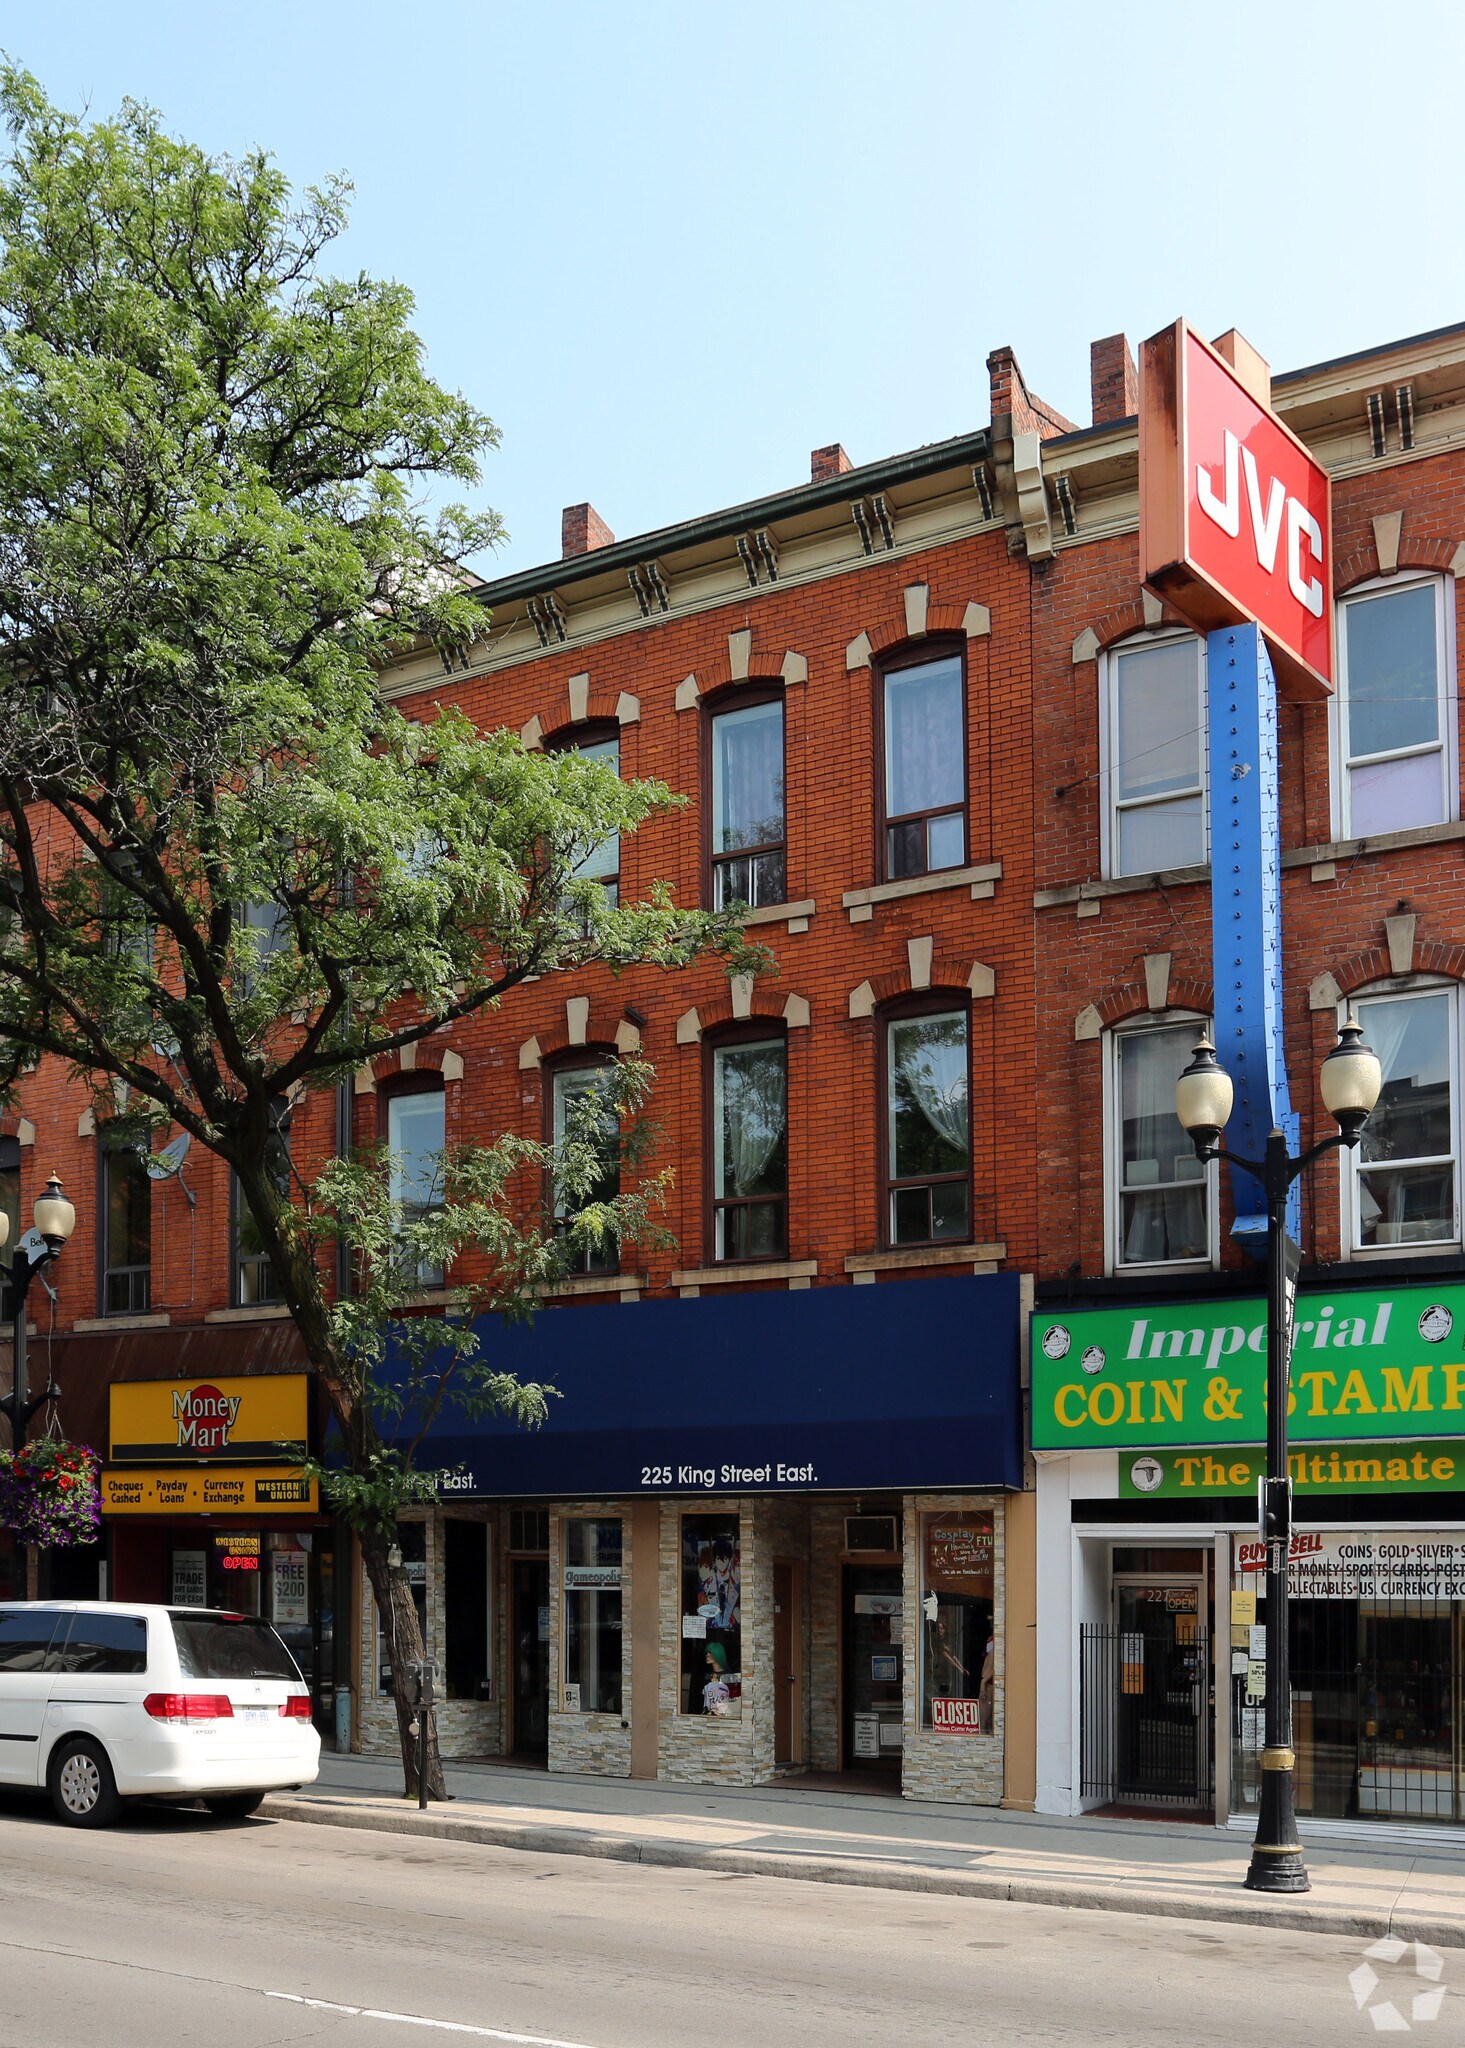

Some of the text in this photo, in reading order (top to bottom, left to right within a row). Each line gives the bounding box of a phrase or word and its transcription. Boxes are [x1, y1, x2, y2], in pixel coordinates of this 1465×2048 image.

[1196, 428, 1323, 619] JVC
[1054, 1379, 1188, 1427] COIN
[1203, 1376, 1243, 1421] &
[171, 1390, 241, 1427] Money
[176, 1420, 230, 1447] Mart
[641, 1463, 818, 1488] 225 King Street East.
[1173, 1455, 1251, 1487] The
[108, 1481, 144, 1492] Cheques
[156, 1480, 188, 1492] Payday
[204, 1479, 244, 1491] Currency
[257, 1482, 299, 1491] WESTERN
[443, 1473, 477, 1489] East.
[111, 1493, 141, 1503] Cashed
[160, 1493, 185, 1503] Loans
[203, 1492, 245, 1505] Exchange
[271, 1491, 299, 1499] UNION
[215, 1537, 258, 1546] WESTERN
[935, 1528, 975, 1543] Cosplay
[229, 1546, 258, 1555] UNION
[1239, 1542, 1267, 1562] BUY
[1289, 1534, 1323, 1555] SELL
[1338, 1545, 1372, 1558] COINS
[1379, 1545, 1410, 1558] GOLD
[1416, 1544, 1453, 1558] SILVER
[223, 1556, 258, 1569] OPEN
[276, 1565, 304, 1580] FREE
[1299, 1563, 1340, 1576] MONEY
[1346, 1563, 1388, 1576] SPORTS
[1393, 1563, 1430, 1576] CARDS
[175, 1572, 204, 1584] TRADE
[187, 1586, 203, 1594] CARDS
[275, 1581, 305, 1598] $200
[1381, 1582, 1441, 1595] CURRENCY
[175, 1595, 204, 1604] FOR CASH
[1147, 1590, 1168, 1602] 227
[1168, 1598, 1195, 1609] OPEN
[933, 1701, 978, 1725] CLOSED
